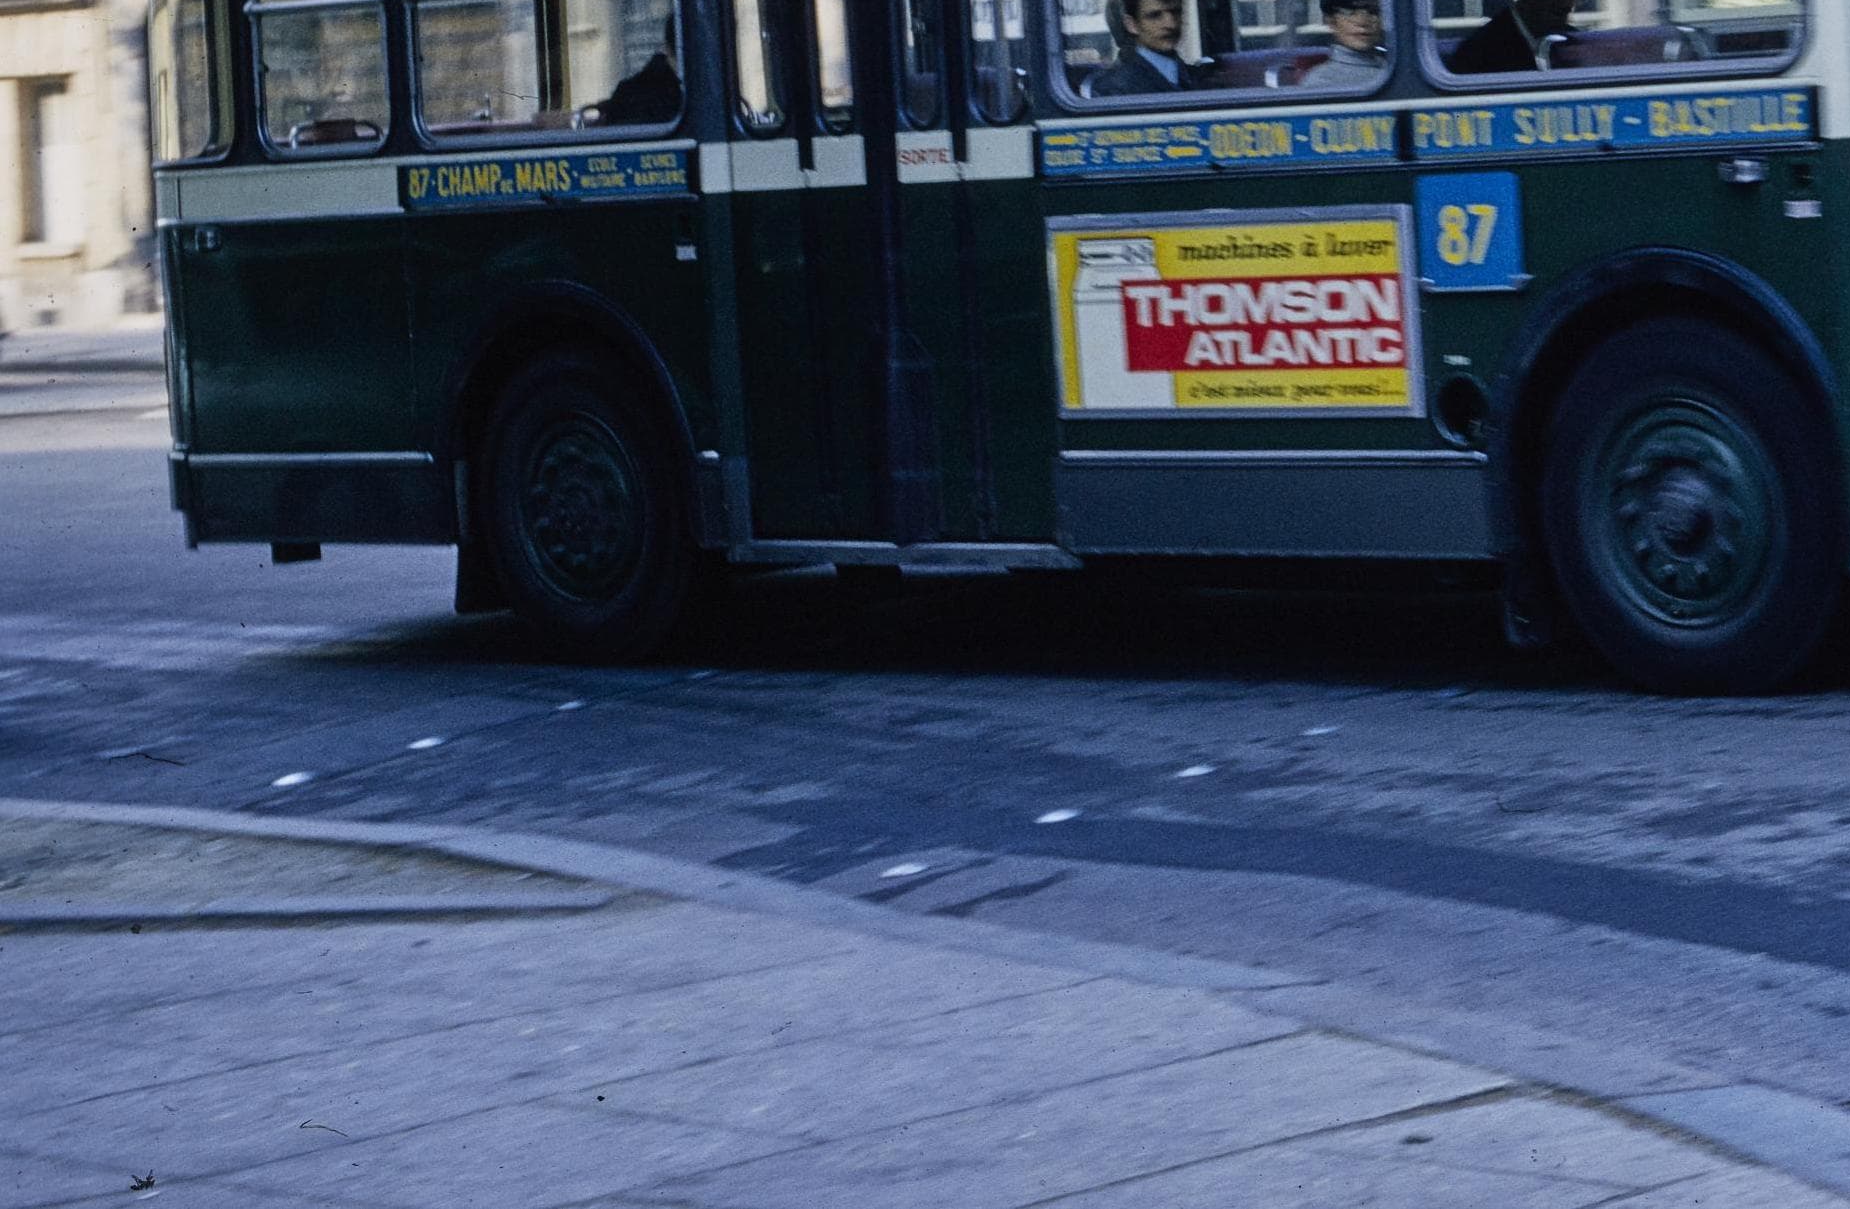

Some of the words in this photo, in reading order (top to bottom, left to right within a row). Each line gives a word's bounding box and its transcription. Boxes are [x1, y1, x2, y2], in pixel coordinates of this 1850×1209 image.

[1413, 110, 1494, 147] PONT
[1513, 104, 1616, 144] SULLY
[1648, 93, 1810, 137] BASTILLE
[409, 168, 431, 199] 87
[436, 162, 501, 198] CHAMP
[514, 159, 571, 192] MARS
[1177, 235, 1294, 261] machines
[1302, 234, 1319, 259] à
[1325, 232, 1394, 258] laver
[1437, 204, 1498, 265] 87
[1125, 279, 1400, 328] THOMSON
[1183, 327, 1404, 366] ATLANTIC
